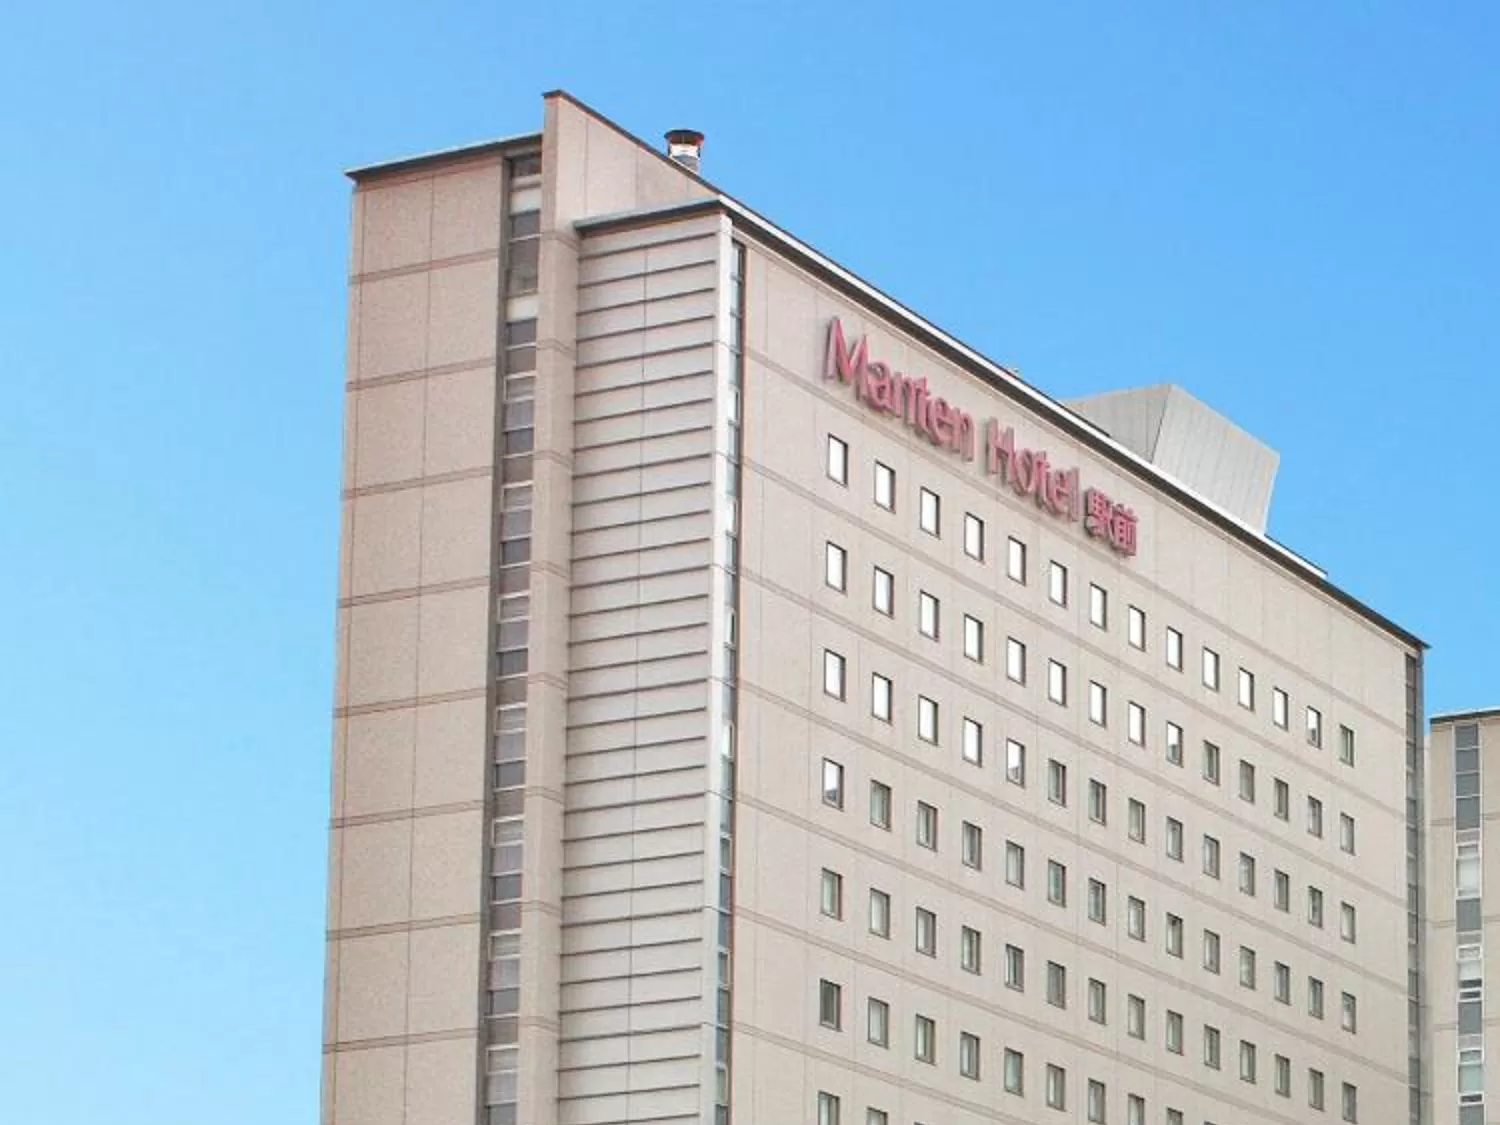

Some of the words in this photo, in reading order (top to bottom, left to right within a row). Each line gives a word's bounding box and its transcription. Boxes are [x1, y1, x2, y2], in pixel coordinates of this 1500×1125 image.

[822, 316, 976, 462] Manten
[985, 417, 1080, 522] Hotel
[1083, 487, 1138, 557] 駅前
